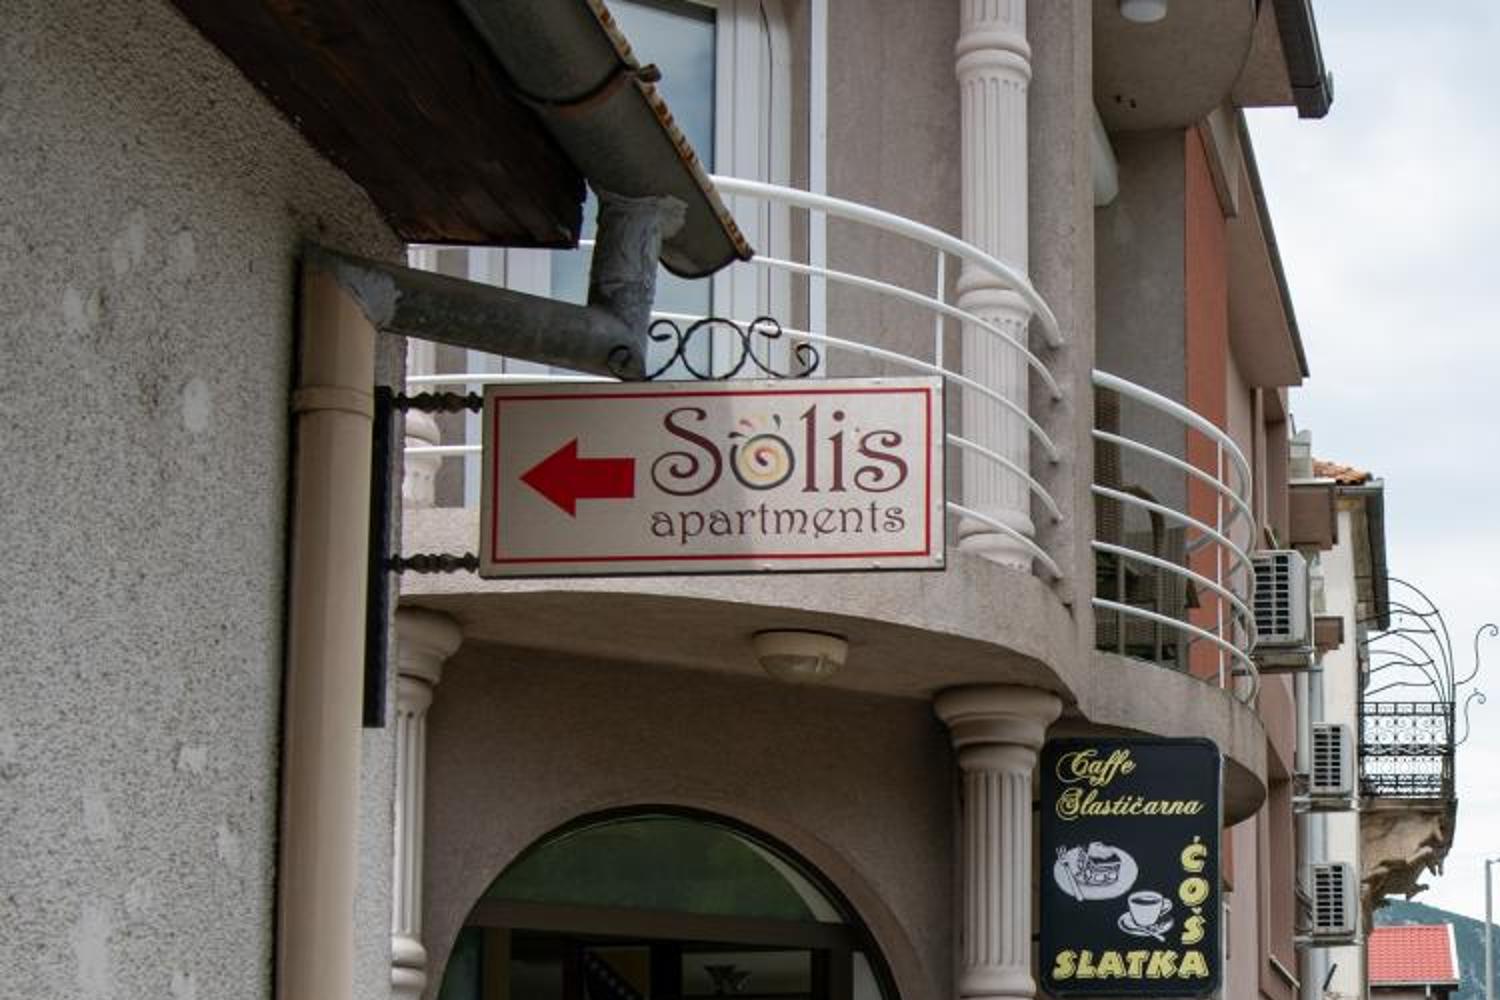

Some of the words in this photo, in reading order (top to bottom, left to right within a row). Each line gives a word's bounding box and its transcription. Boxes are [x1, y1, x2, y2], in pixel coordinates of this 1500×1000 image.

[650, 500, 906, 545] apartments
[1055, 749, 1136, 786] Caffe
[1055, 787, 1204, 820] Slastičarna
[1053, 950, 1209, 979] SLATKA
